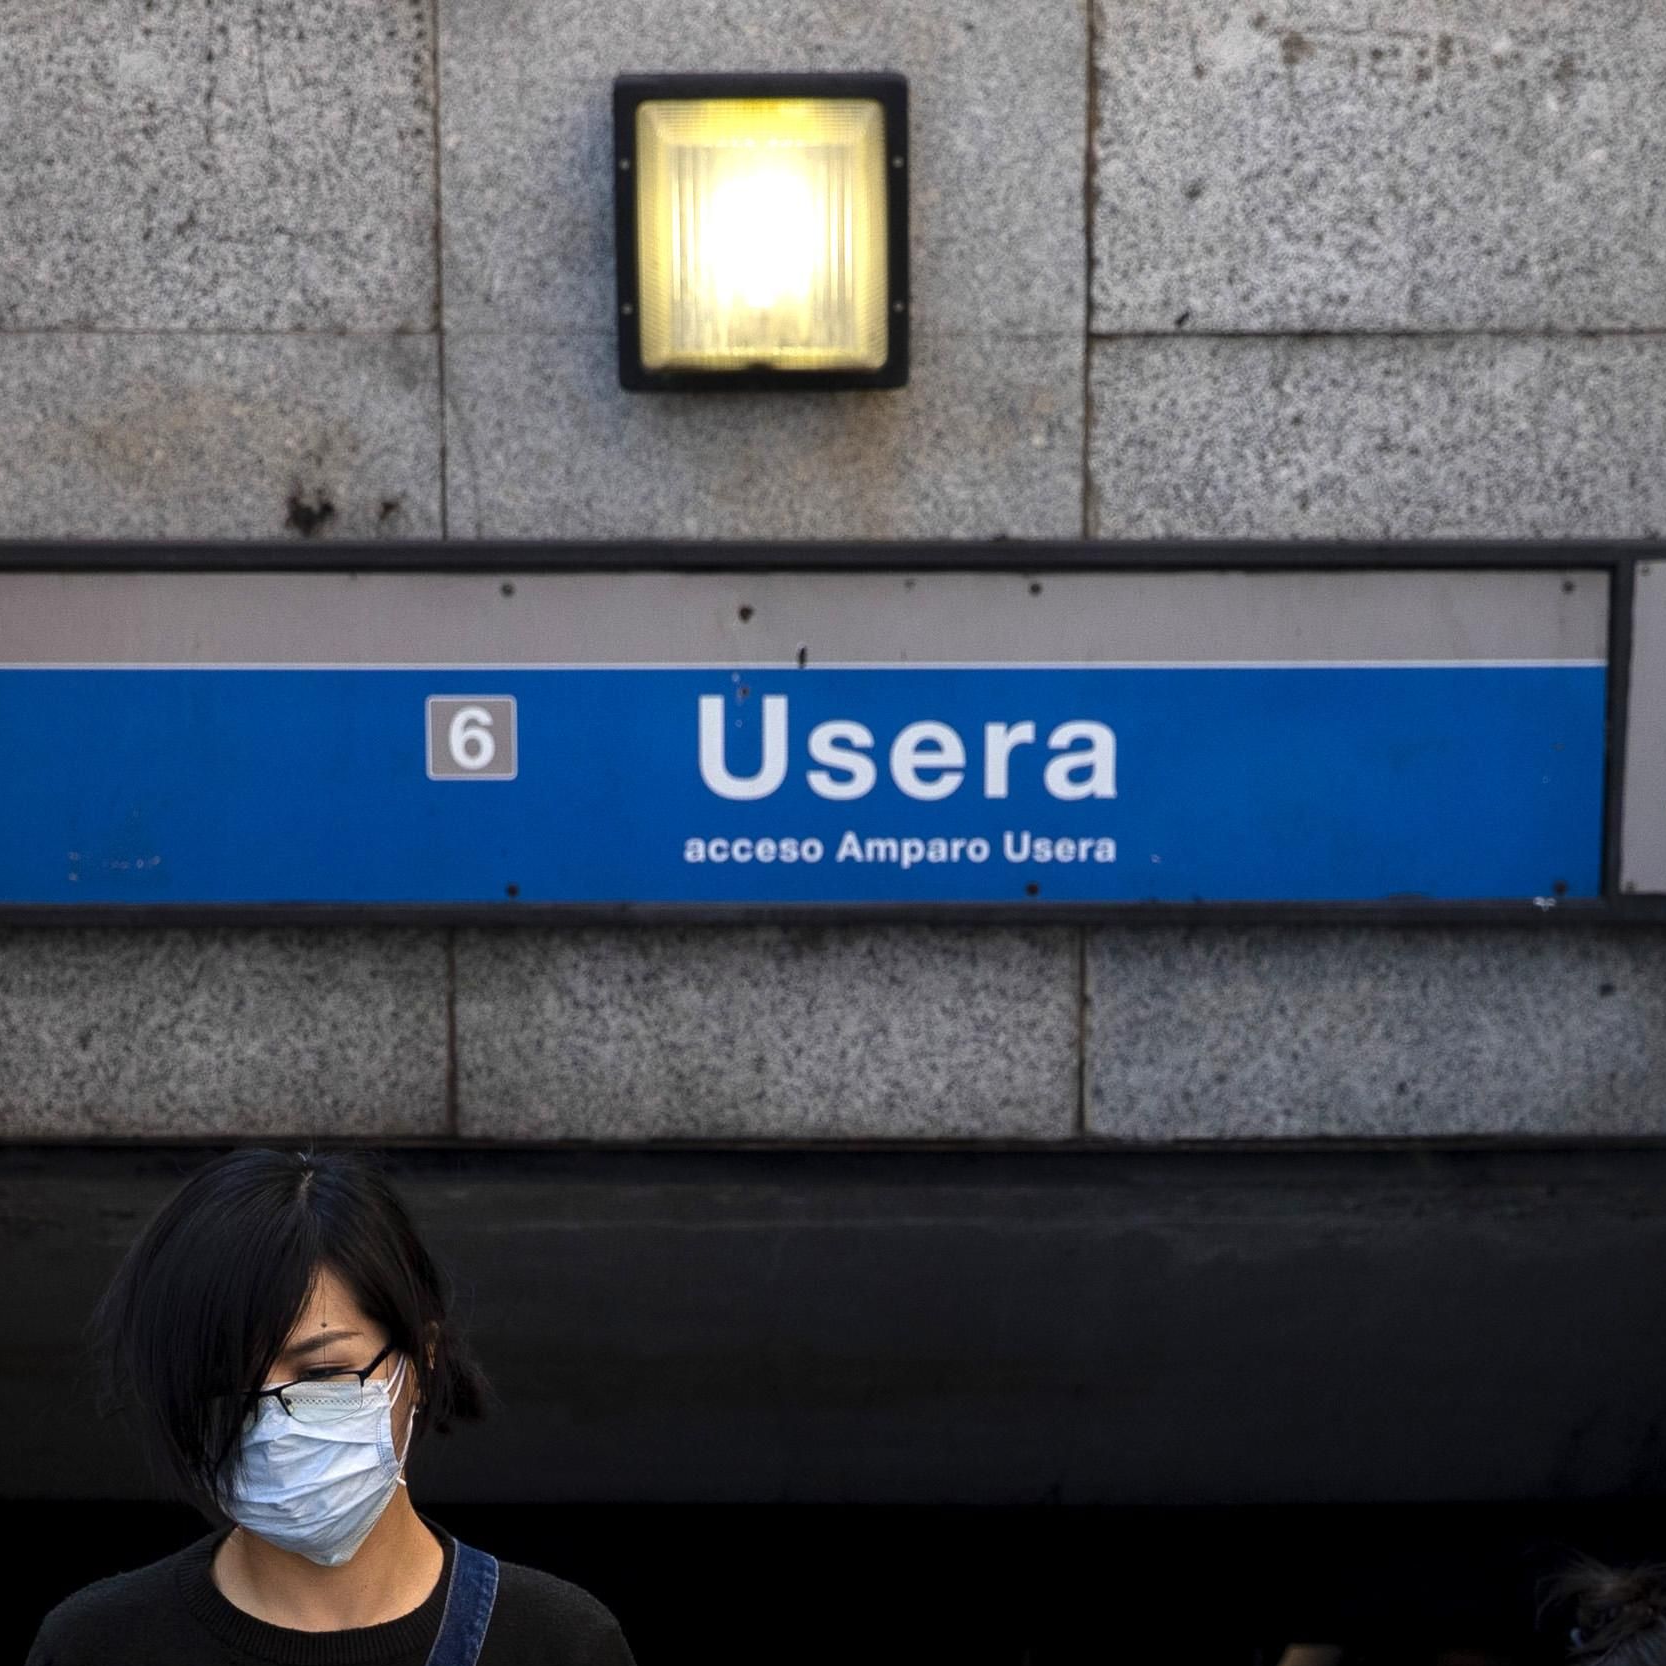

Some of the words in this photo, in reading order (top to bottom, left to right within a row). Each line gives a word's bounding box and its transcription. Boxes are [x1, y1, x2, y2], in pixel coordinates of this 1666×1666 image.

[448, 706, 496, 770] 6
[698, 695, 1117, 801] Usera
[683, 837, 825, 864] acceso
[836, 831, 991, 869] Amparo
[1003, 831, 1117, 864] Usera
